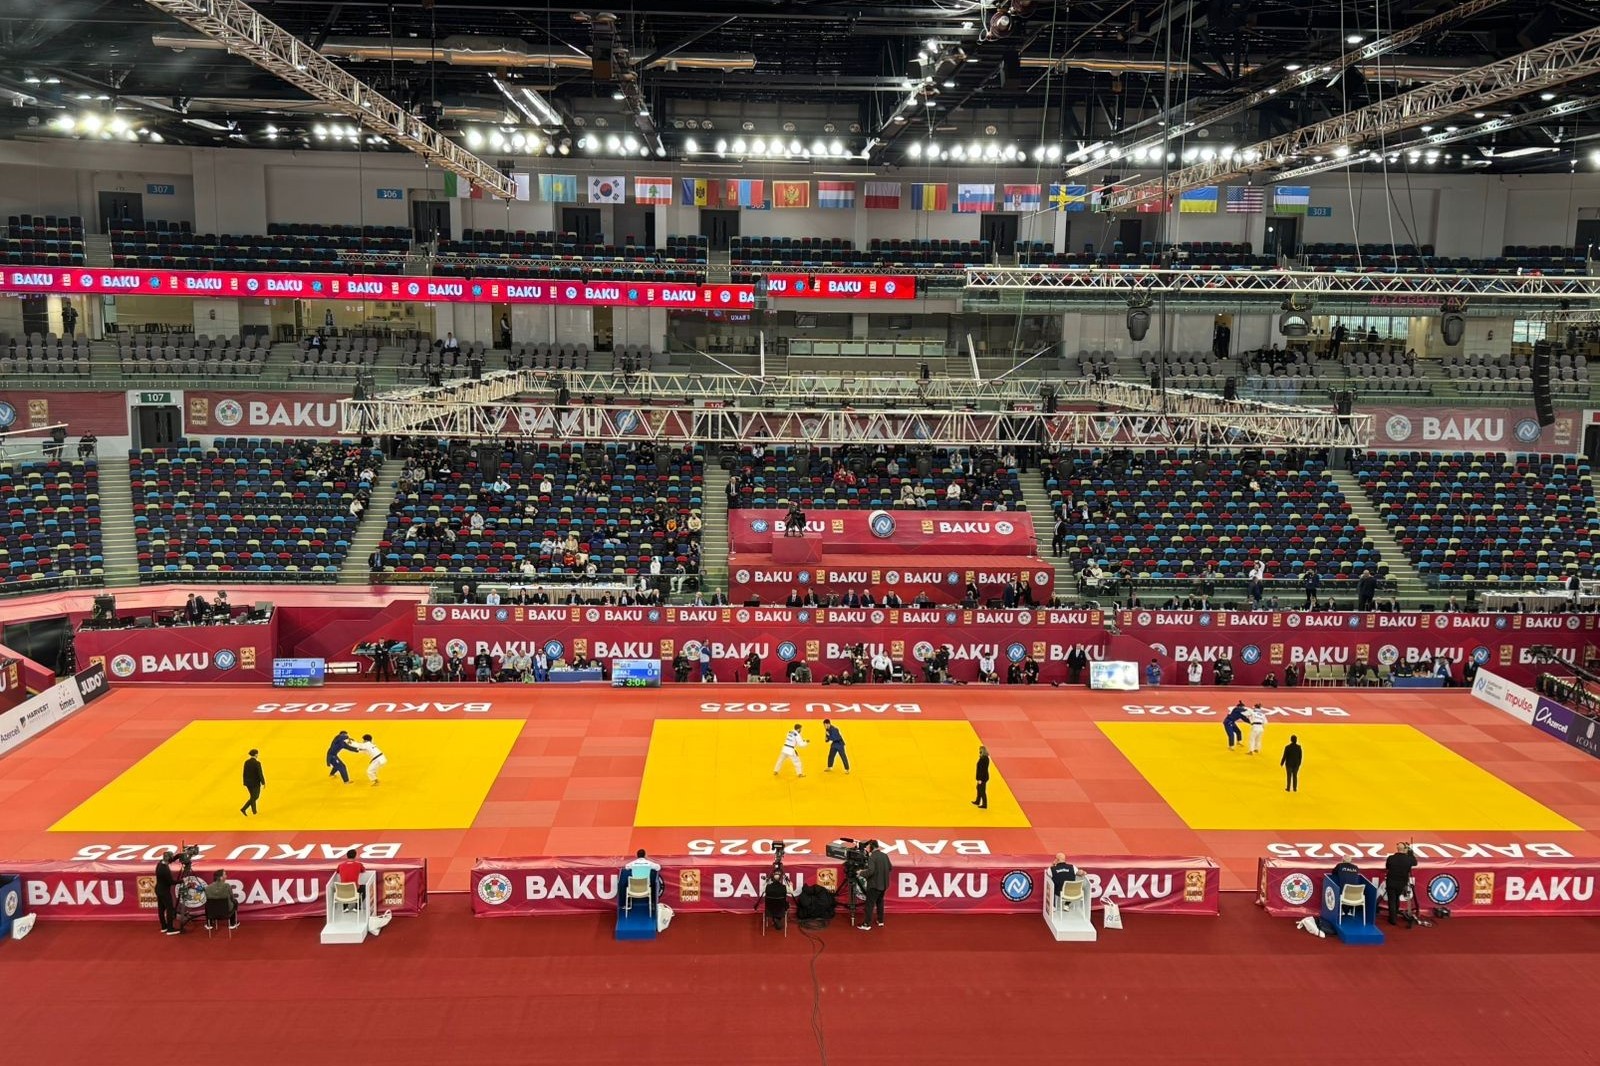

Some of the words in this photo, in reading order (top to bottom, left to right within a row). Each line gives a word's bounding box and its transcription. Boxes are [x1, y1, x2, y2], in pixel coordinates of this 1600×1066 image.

[152, 186, 168, 194] 307
[1312, 208, 1326, 216] 303
[13, 273, 53, 286] BAKU
[102, 275, 140, 288] BAKU
[187, 278, 222, 290] BAKU
[267, 280, 303, 292] BAKU
[348, 282, 383, 294] BAKU
[428, 284, 463, 296] BAKU
[507, 286, 542, 298] BAKU
[828, 281, 862, 292] BAKU
[585, 288, 620, 300] BAKU
[662, 290, 696, 302] BAKU
[148, 393, 164, 402] 107
[250, 401, 336, 426] BAKU
[1423, 416, 1504, 441] BAKU
[774, 520, 825, 532] BKU
[939, 522, 990, 533] BAKU
[754, 571, 792, 582] BAKU
[830, 572, 867, 583] BAKU
[904, 572, 942, 584] BAKU
[451, 608, 490, 620] BAKU
[528, 609, 566, 620] BAKU
[604, 610, 642, 621] BAKU
[680, 611, 717, 622] BAKU
[754, 611, 792, 622] BAKU
[829, 612, 866, 622] BAKU
[903, 612, 940, 623] BAKU
[976, 612, 1014, 623] BAKU
[1050, 613, 1088, 624] BAKU
[1156, 614, 1193, 625] BAKU
[1230, 615, 1268, 626] BAKU
[1305, 615, 1342, 626] BAKU
[1380, 616, 1417, 627] BAKU
[1453, 616, 1490, 628] BAKU
[1526, 617, 1562, 628] BAKU
[476, 641, 536, 658] BAKU
[595, 642, 653, 658] BAKU
[712, 643, 769, 659] BAKU
[1175, 646, 1233, 661] BAKU
[1291, 647, 1349, 662] BAKU
[1406, 647, 1464, 663] BAKU
[142, 652, 209, 673] BAKU
[59, 697, 75, 710] times
[1504, 690, 1533, 712] impulse
[26, 702, 49, 719] HARVEST
[252, 702, 357, 713] 2025
[366, 702, 492, 713] BAKU
[700, 703, 790, 713] 2025
[805, 703, 922, 713] BAKU
[1122, 705, 1217, 715] 2025
[1546, 717, 1568, 734] Azercell
[225, 843, 404, 860] BAKU
[687, 839, 811, 855] 2025
[1267, 842, 1399, 858] 2025
[1408, 842, 1576, 858] BAKU
[229, 878, 319, 904] BAKU
[525, 875, 618, 900] BAKU
[713, 873, 803, 898] BAU
[898, 872, 988, 898] BAKU
[1086, 874, 1172, 899] BAKU
[1505, 876, 1594, 901] BAKU
[27, 880, 124, 905] BAKU
